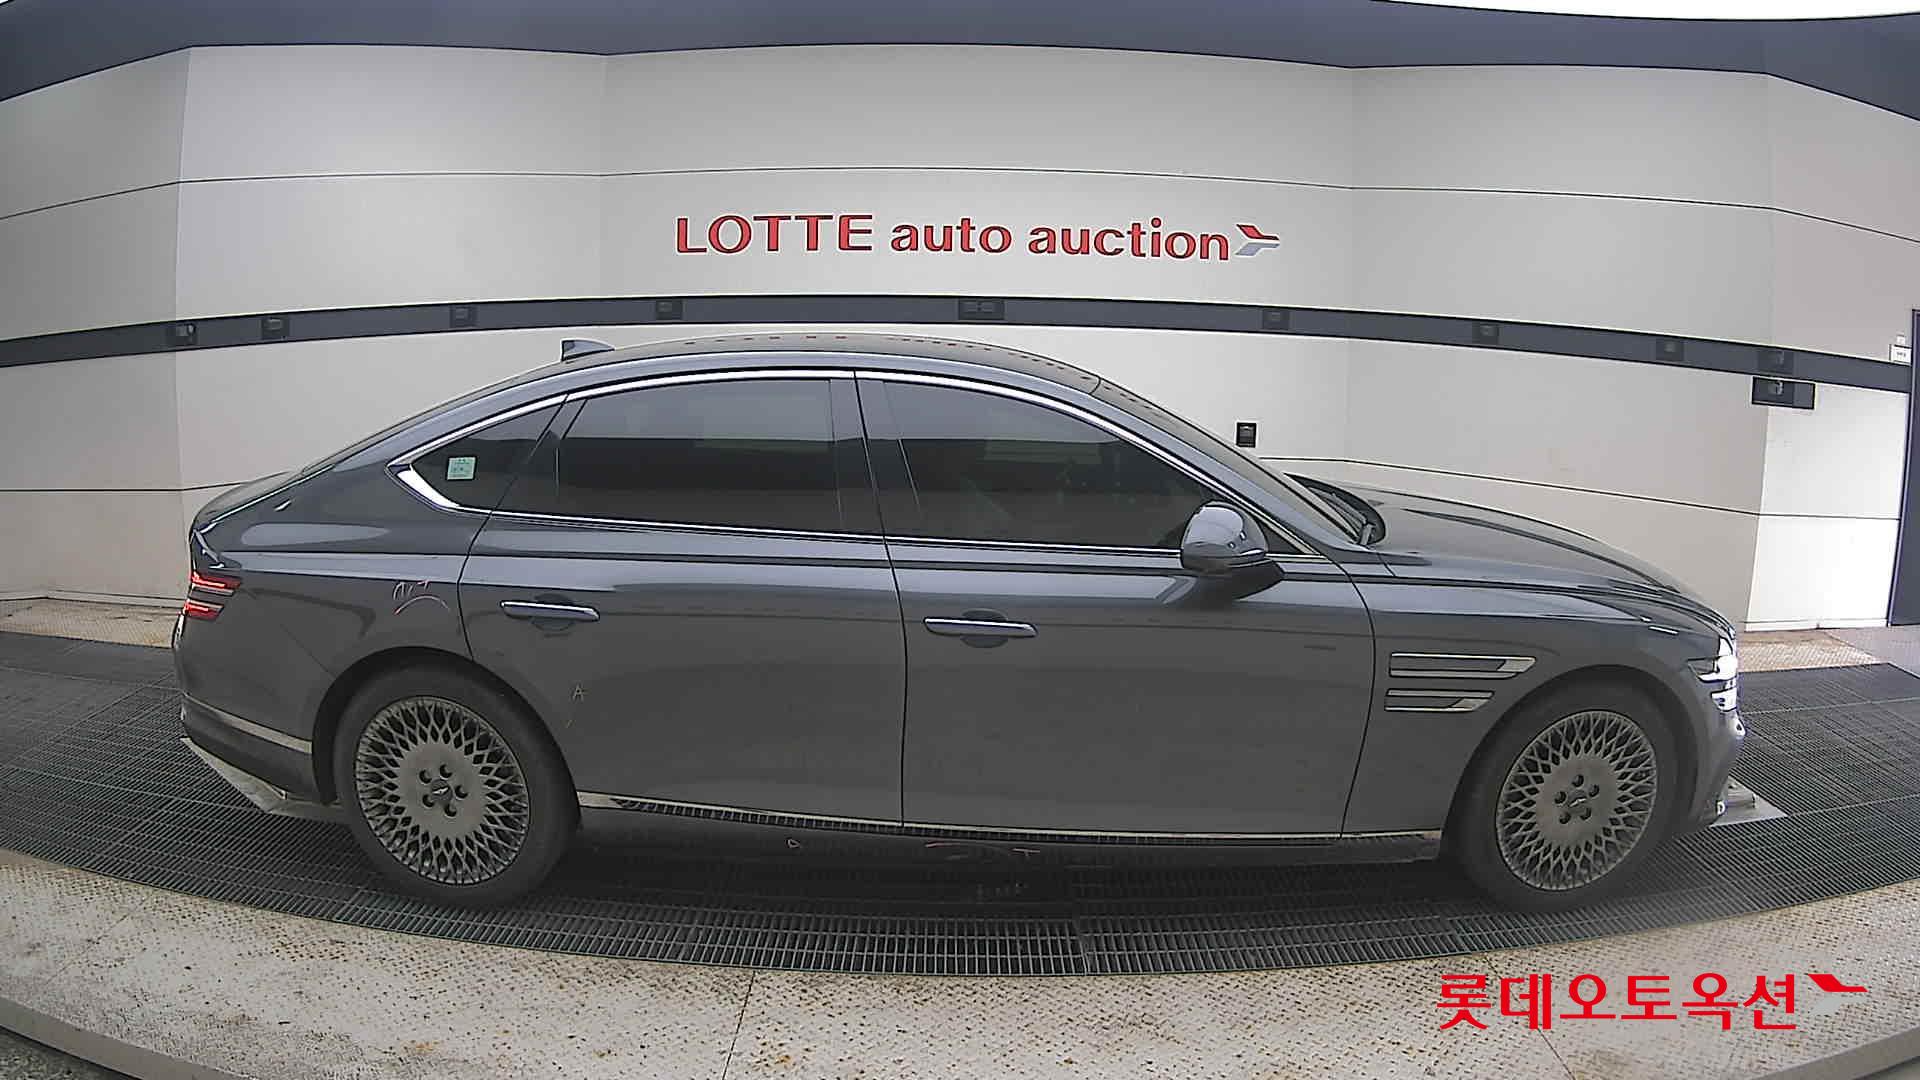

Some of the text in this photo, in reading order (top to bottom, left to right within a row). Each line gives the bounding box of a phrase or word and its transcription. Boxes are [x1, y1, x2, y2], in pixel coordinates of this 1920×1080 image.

[677, 214, 1229, 261] LOTTE auto auction
